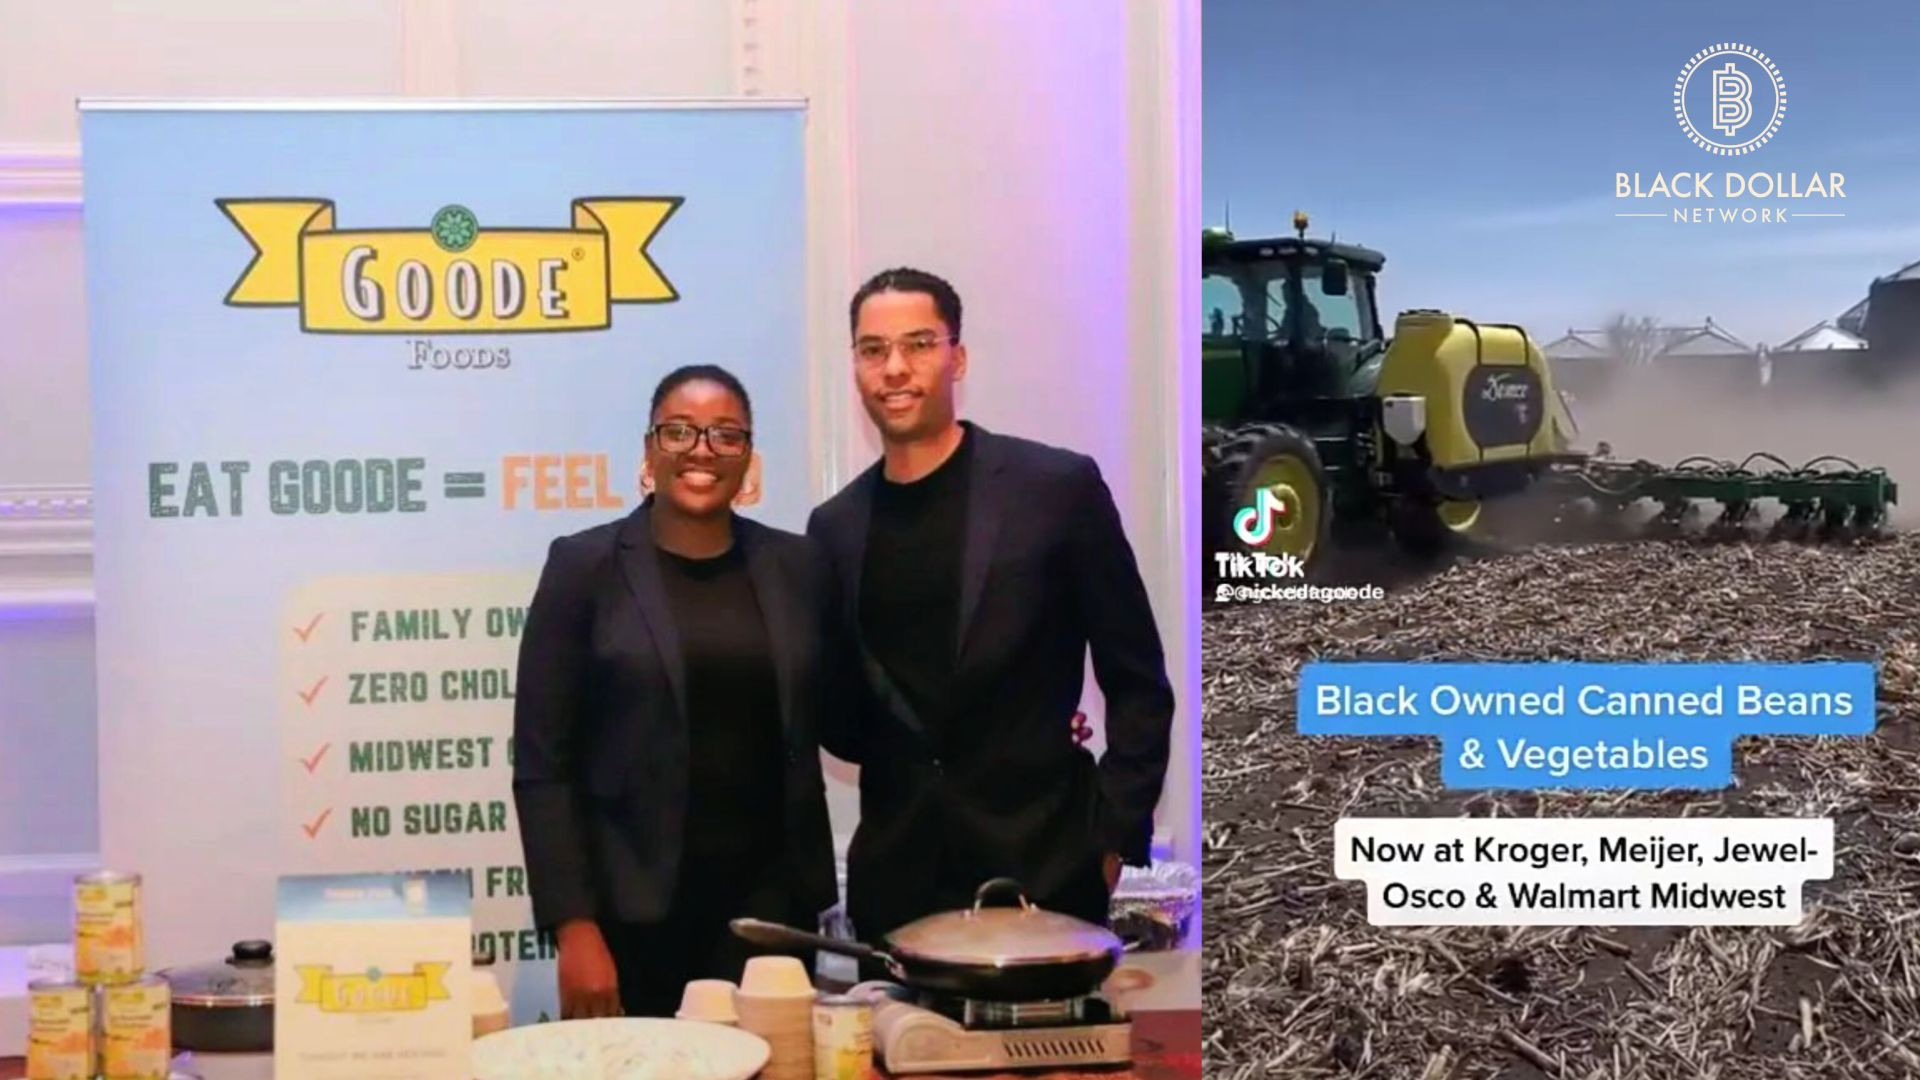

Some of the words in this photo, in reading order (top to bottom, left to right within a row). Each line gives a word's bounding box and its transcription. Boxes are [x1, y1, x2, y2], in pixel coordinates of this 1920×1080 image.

[341, 245, 569, 321] GOODE
[147, 460, 250, 518] EAT
[268, 457, 427, 515] GOODE
[502, 453, 624, 511] FEEL
[351, 608, 472, 642] FAMILY
[348, 672, 428, 704] ZERO
[441, 669, 516, 701] CHOL
[349, 737, 493, 772] MIDWEST
[351, 807, 391, 838] NO
[403, 802, 506, 836] SUGAR
[486, 865, 532, 898] FR
